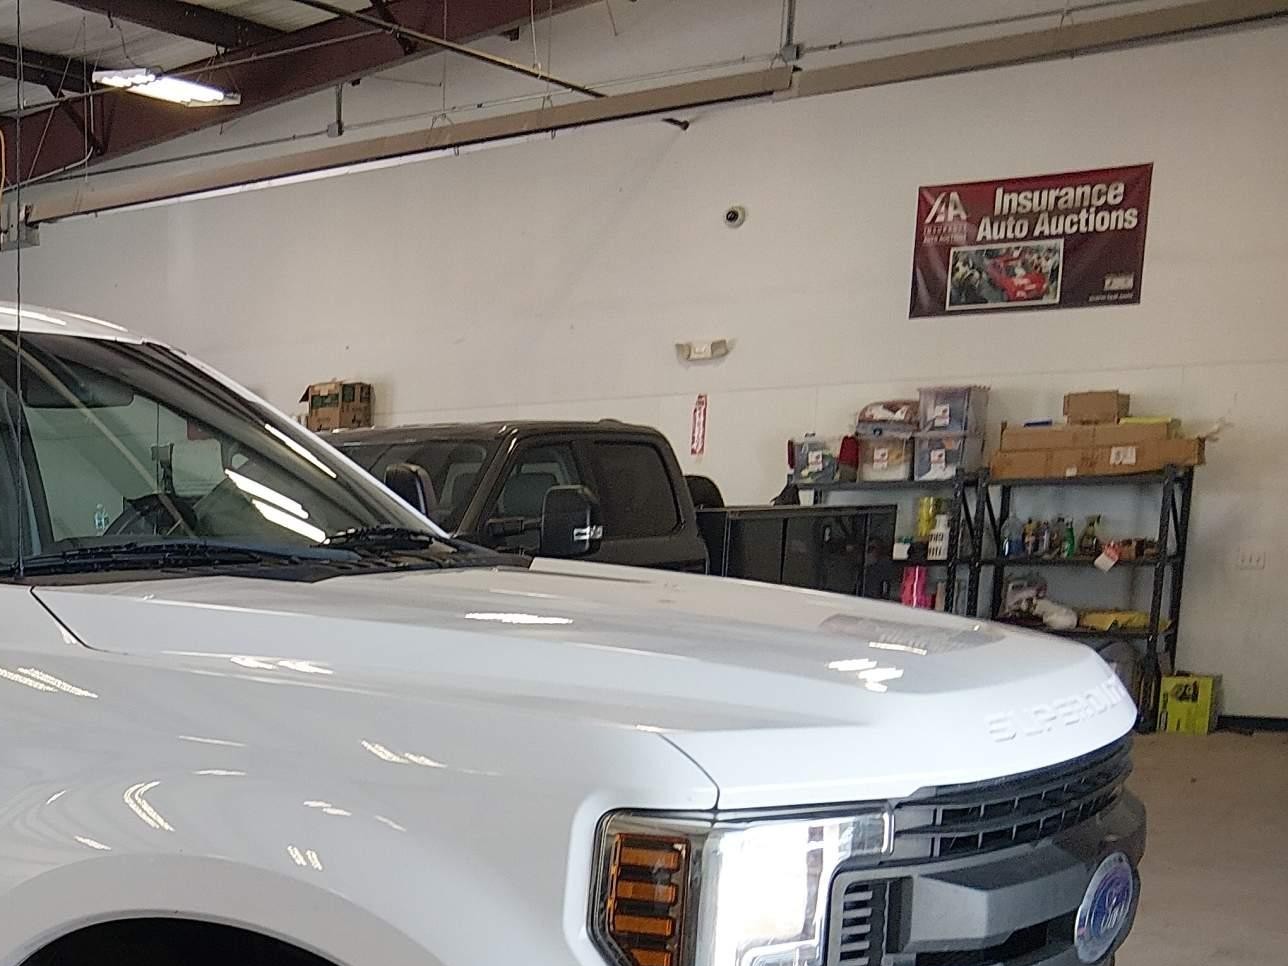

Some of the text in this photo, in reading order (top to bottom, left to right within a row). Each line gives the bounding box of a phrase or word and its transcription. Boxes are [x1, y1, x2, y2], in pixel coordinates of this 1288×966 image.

[993, 181, 1125, 216] Insurance
[976, 207, 1138, 242] Auto Auctions
